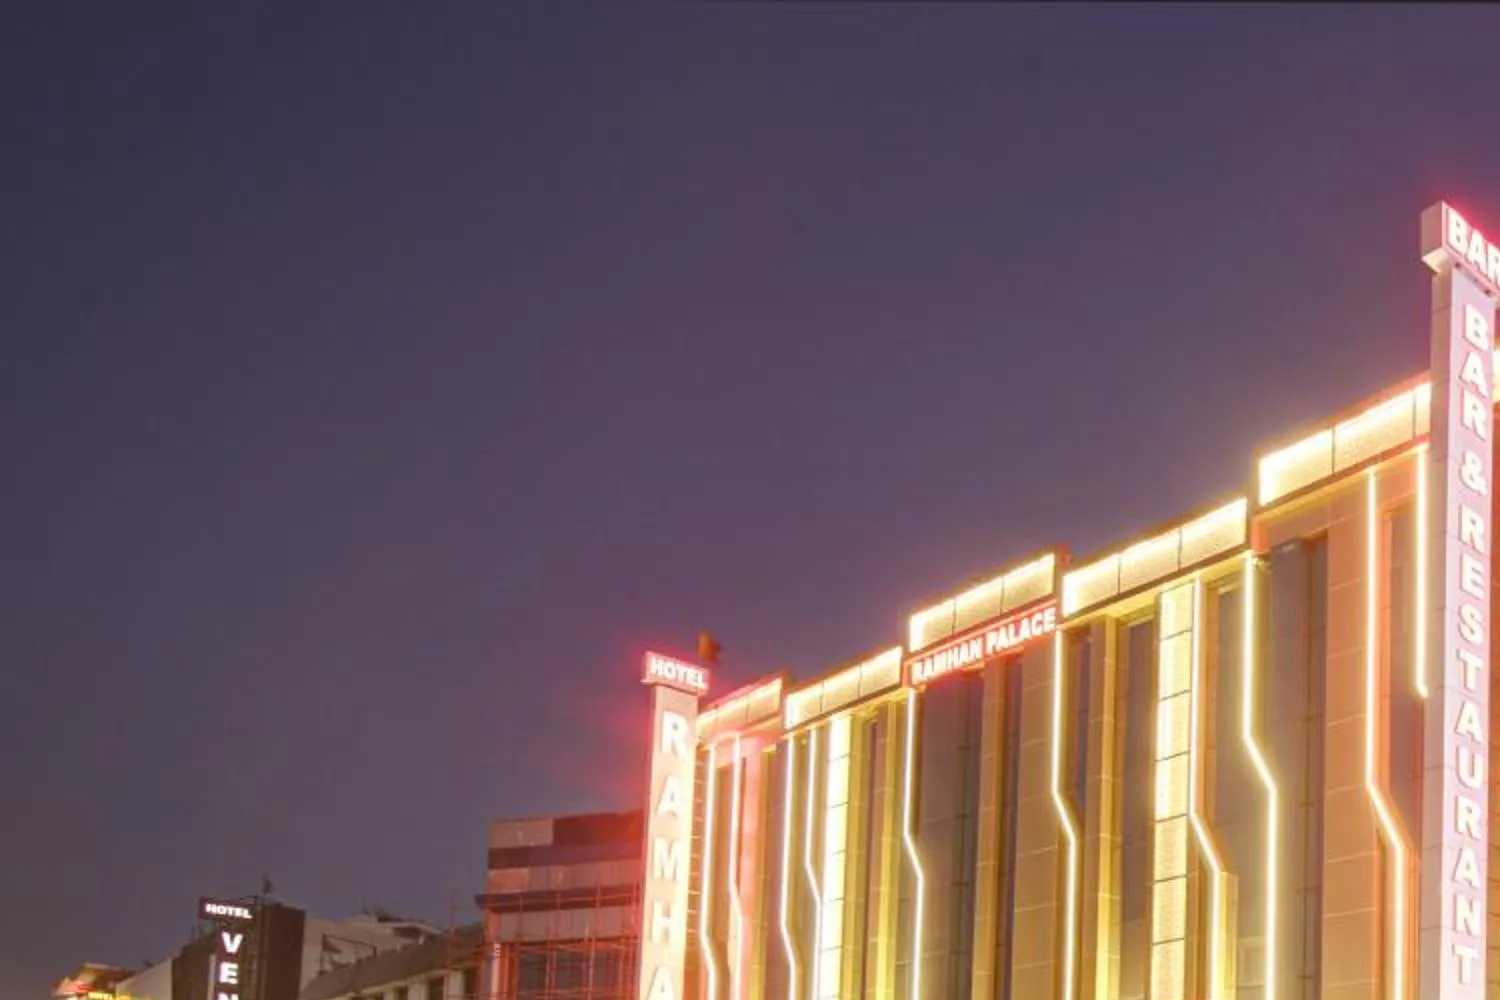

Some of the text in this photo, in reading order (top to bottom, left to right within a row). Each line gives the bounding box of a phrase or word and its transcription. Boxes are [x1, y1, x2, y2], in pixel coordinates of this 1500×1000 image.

[986, 606, 1057, 655] PALACE
[1450, 303, 1490, 986] BAR & RESTAURANT
[650, 656, 706, 689] HOTEL
[205, 903, 253, 919] HOTEL
